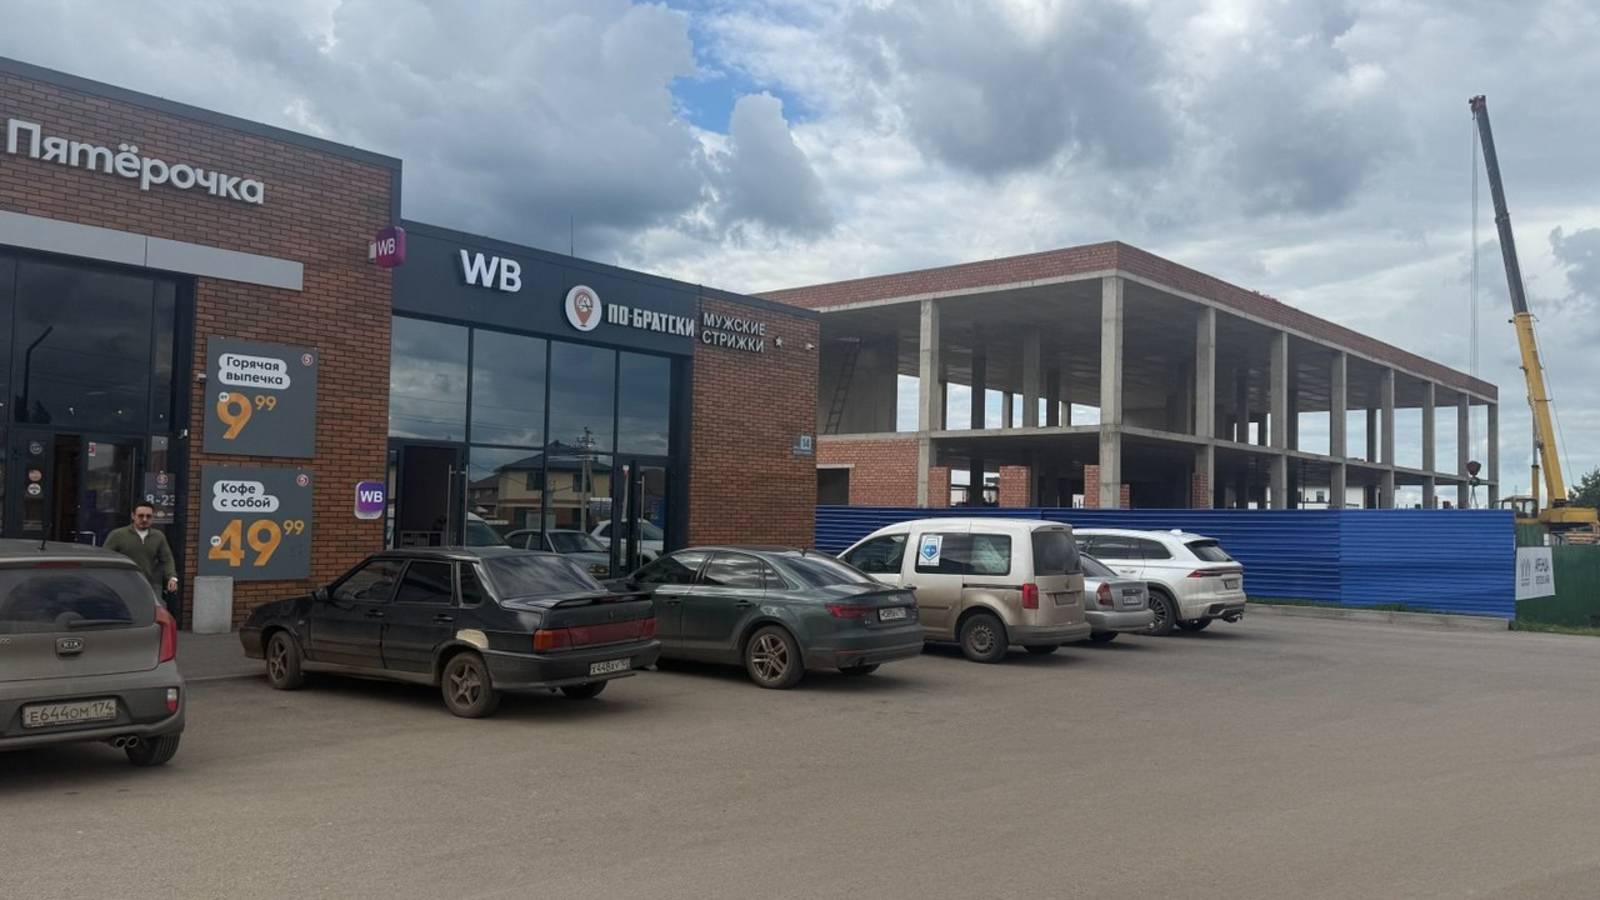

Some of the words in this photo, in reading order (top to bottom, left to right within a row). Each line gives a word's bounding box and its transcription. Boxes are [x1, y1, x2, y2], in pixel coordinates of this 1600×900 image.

[7, 118, 265, 205] Пятёрочка
[378, 237, 395, 255] WB
[459, 249, 522, 293] WB
[607, 303, 695, 337] ПО-БРАТСКИ
[704, 313, 766, 336] МУЖСКИЕ
[702, 333, 764, 353] СТРИЖКИ
[226, 356, 280, 371] Горячая
[226, 372, 283, 384] выпечка
[217, 392, 252, 439] 9
[255, 395, 276, 410] 99
[221, 483, 256, 496] Кофе
[360, 490, 383, 503] WB
[220, 498, 228, 508] с
[231, 496, 271, 508] собой
[208, 519, 282, 567] 49
[283, 519, 305, 535] 99
[63, 640, 80, 649] KIA
